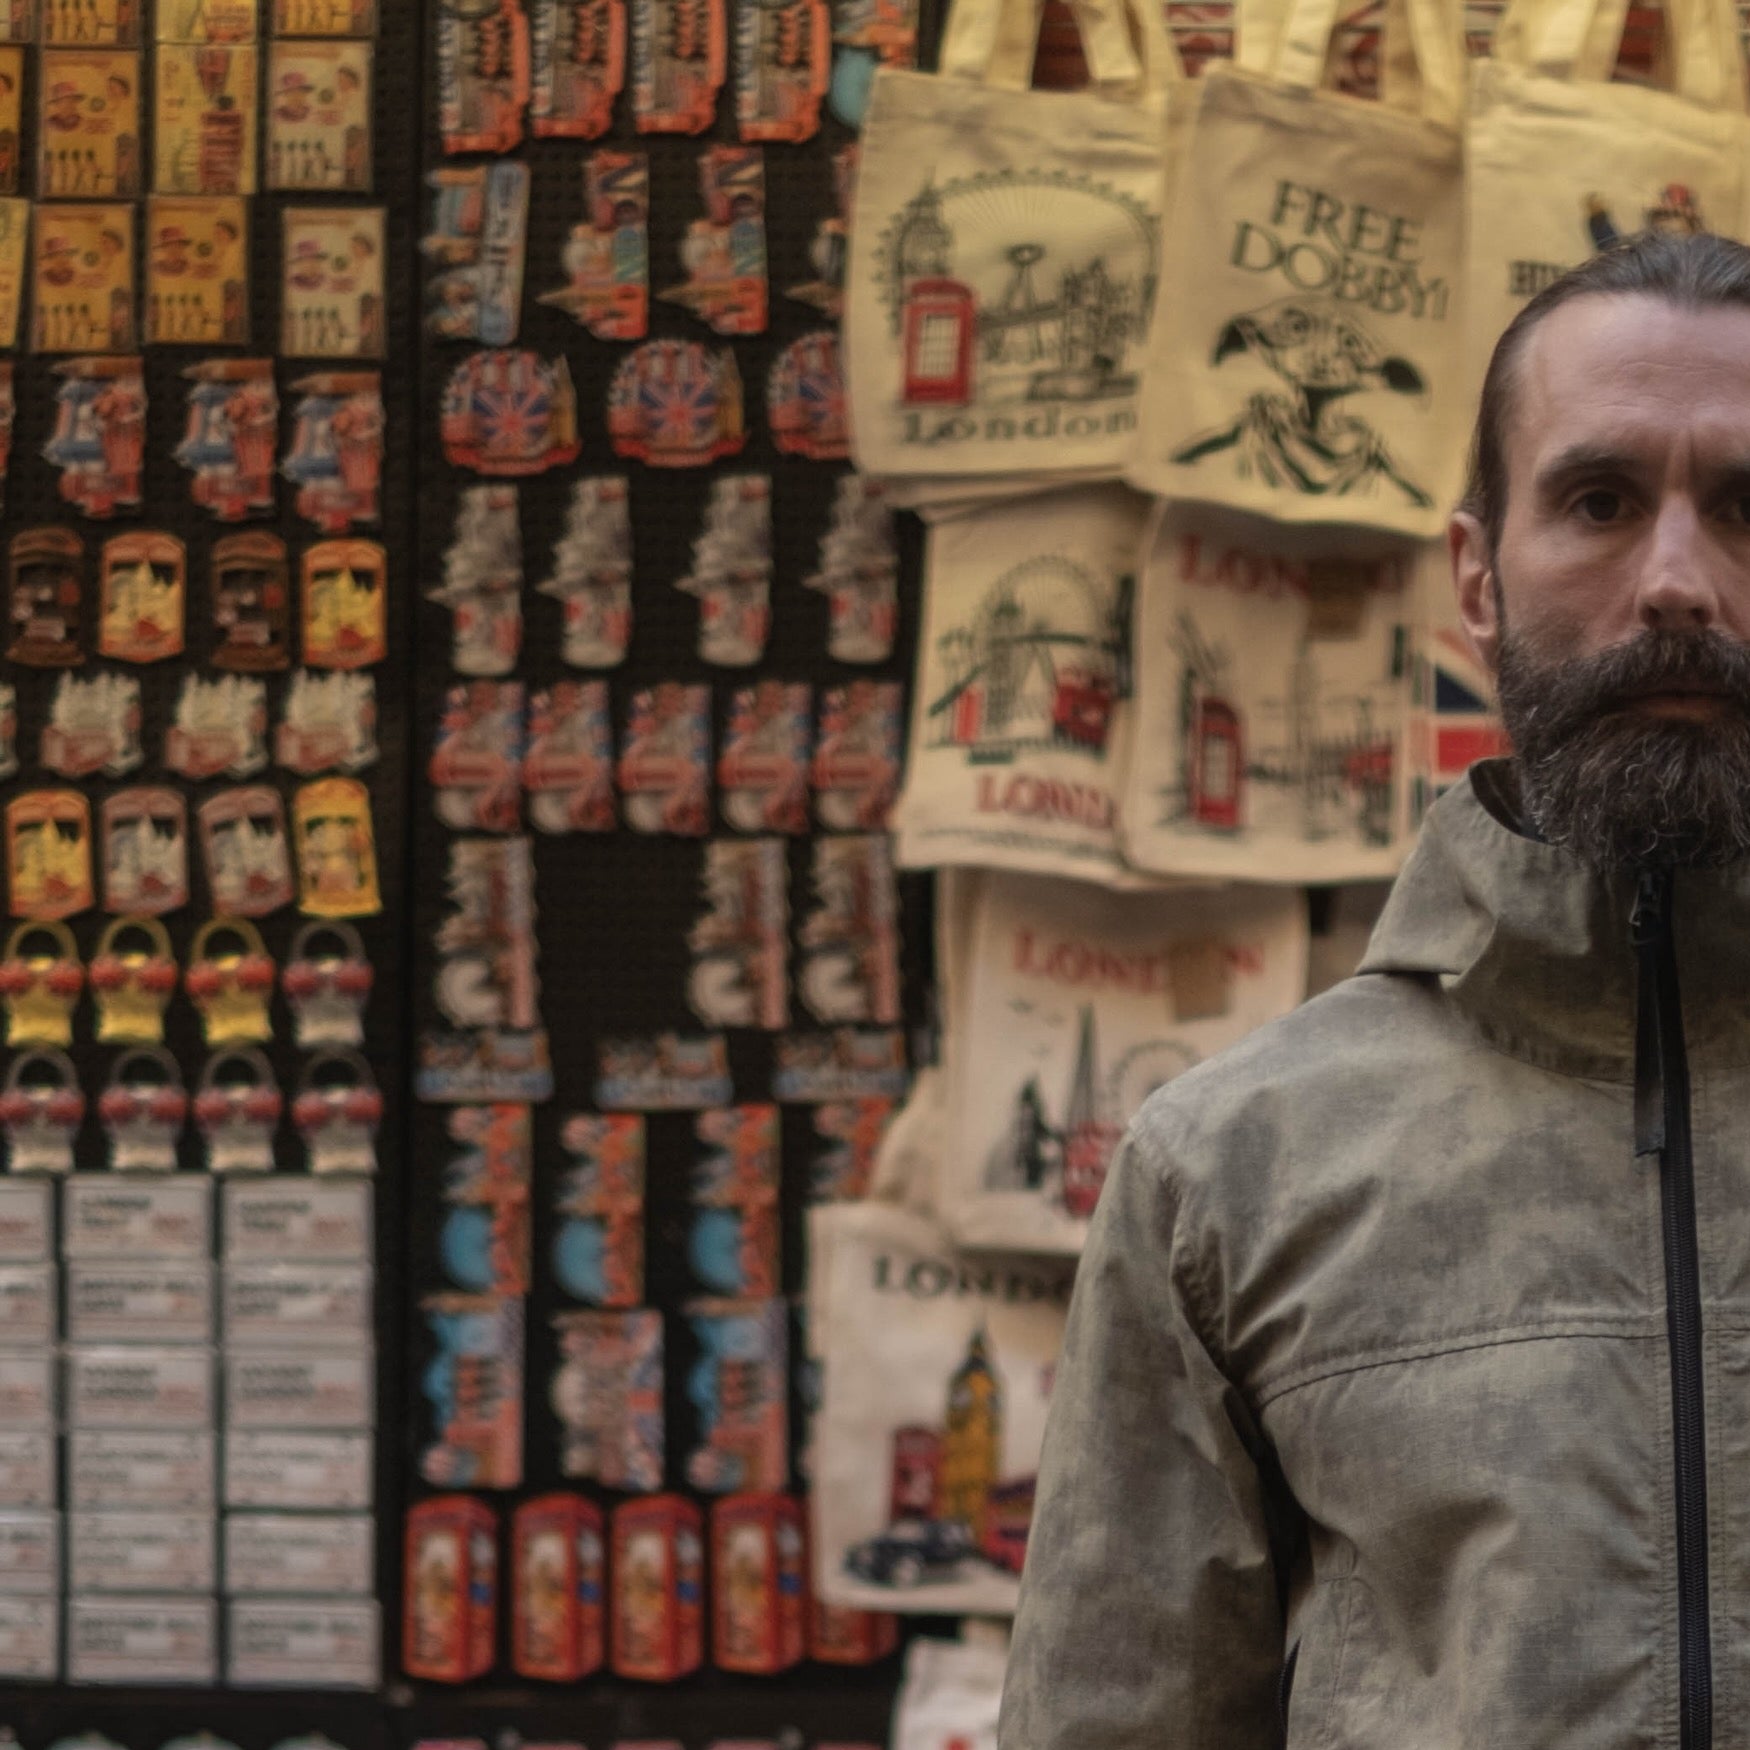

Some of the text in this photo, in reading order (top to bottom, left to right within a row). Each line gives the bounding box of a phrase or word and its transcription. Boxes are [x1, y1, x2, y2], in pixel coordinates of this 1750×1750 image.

[1271, 178, 1422, 261] FREE
[1230, 221, 1449, 321] DOBBY!
[902, 408, 1138, 446] London
